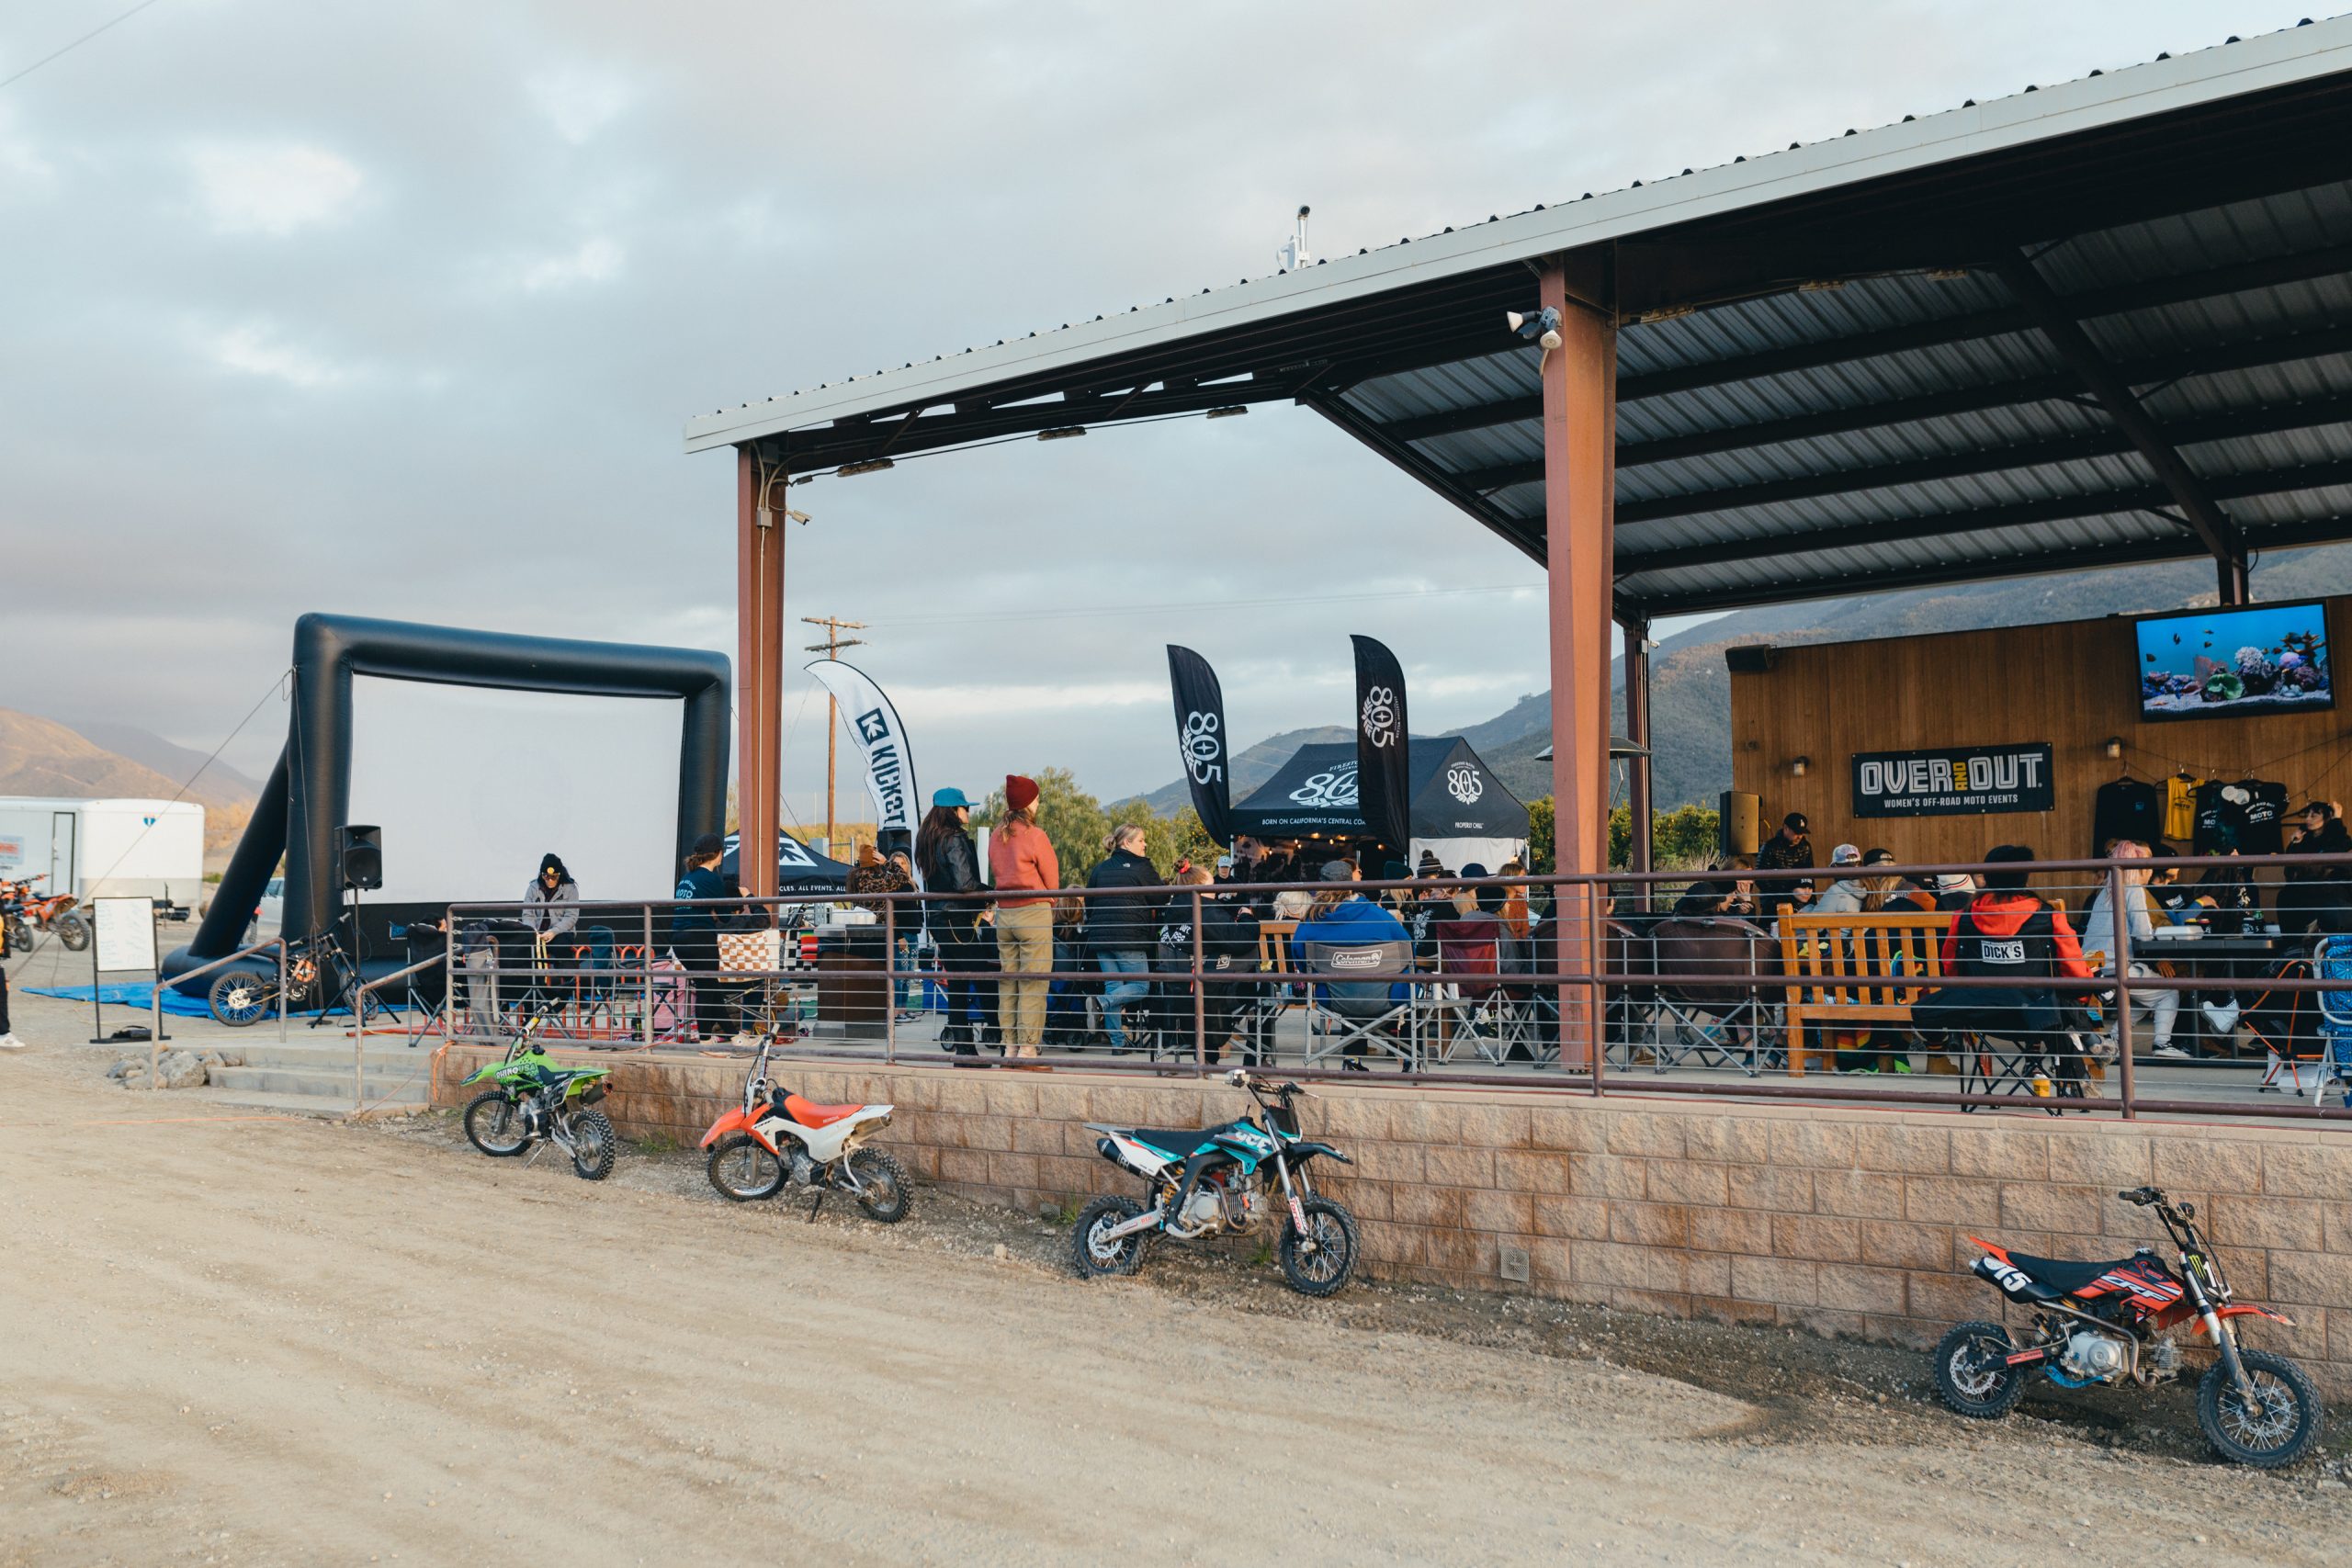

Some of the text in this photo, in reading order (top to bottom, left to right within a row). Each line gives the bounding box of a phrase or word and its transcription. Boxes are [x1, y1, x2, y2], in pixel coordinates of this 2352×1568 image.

[1370, 686, 1394, 748] 805
[1188, 711, 1222, 784] 805
[871, 744, 907, 830] KICKST
[1289, 771, 1358, 801] 80
[1447, 770, 1483, 795] 805
[1860, 759, 1953, 795] OVER
[1952, 761, 1968, 791] AND
[1884, 794, 2018, 808] WOMEN'S OFF-ROAD MOTO EVENTS
[2250, 810, 2273, 820] MOTO
[1335, 954, 1371, 964] Coleman
